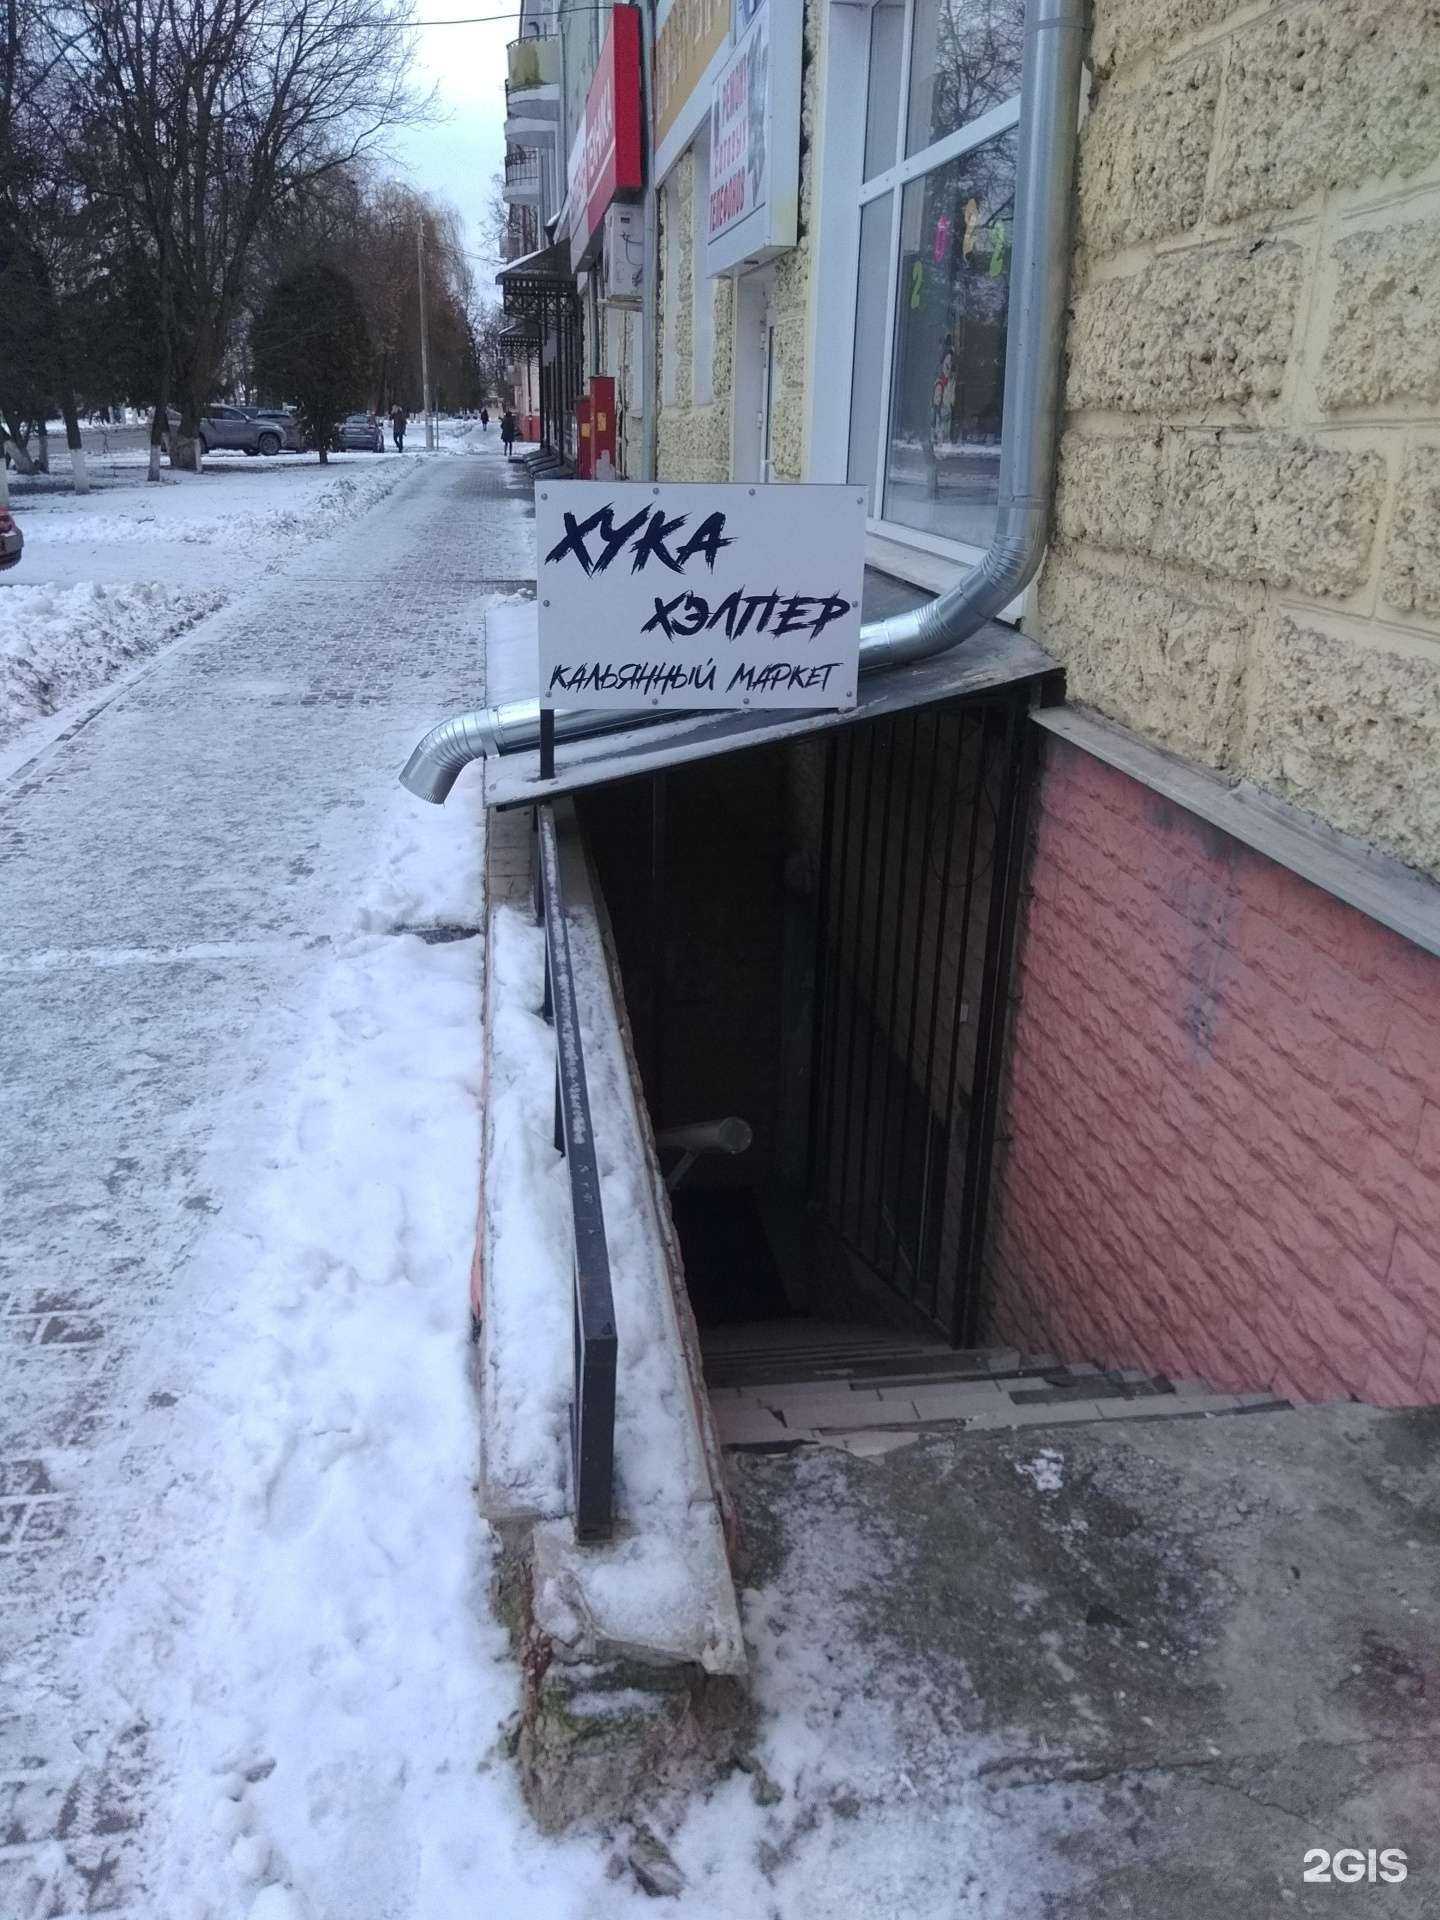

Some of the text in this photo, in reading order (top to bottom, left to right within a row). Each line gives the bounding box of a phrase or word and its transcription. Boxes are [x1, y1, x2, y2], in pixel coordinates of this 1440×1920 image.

[545, 501, 739, 578] ХУКА
[640, 584, 851, 642] ХЭЛПЕР
[549, 657, 845, 695] КАЛЬЯННЫЙ МАРКЕТ
